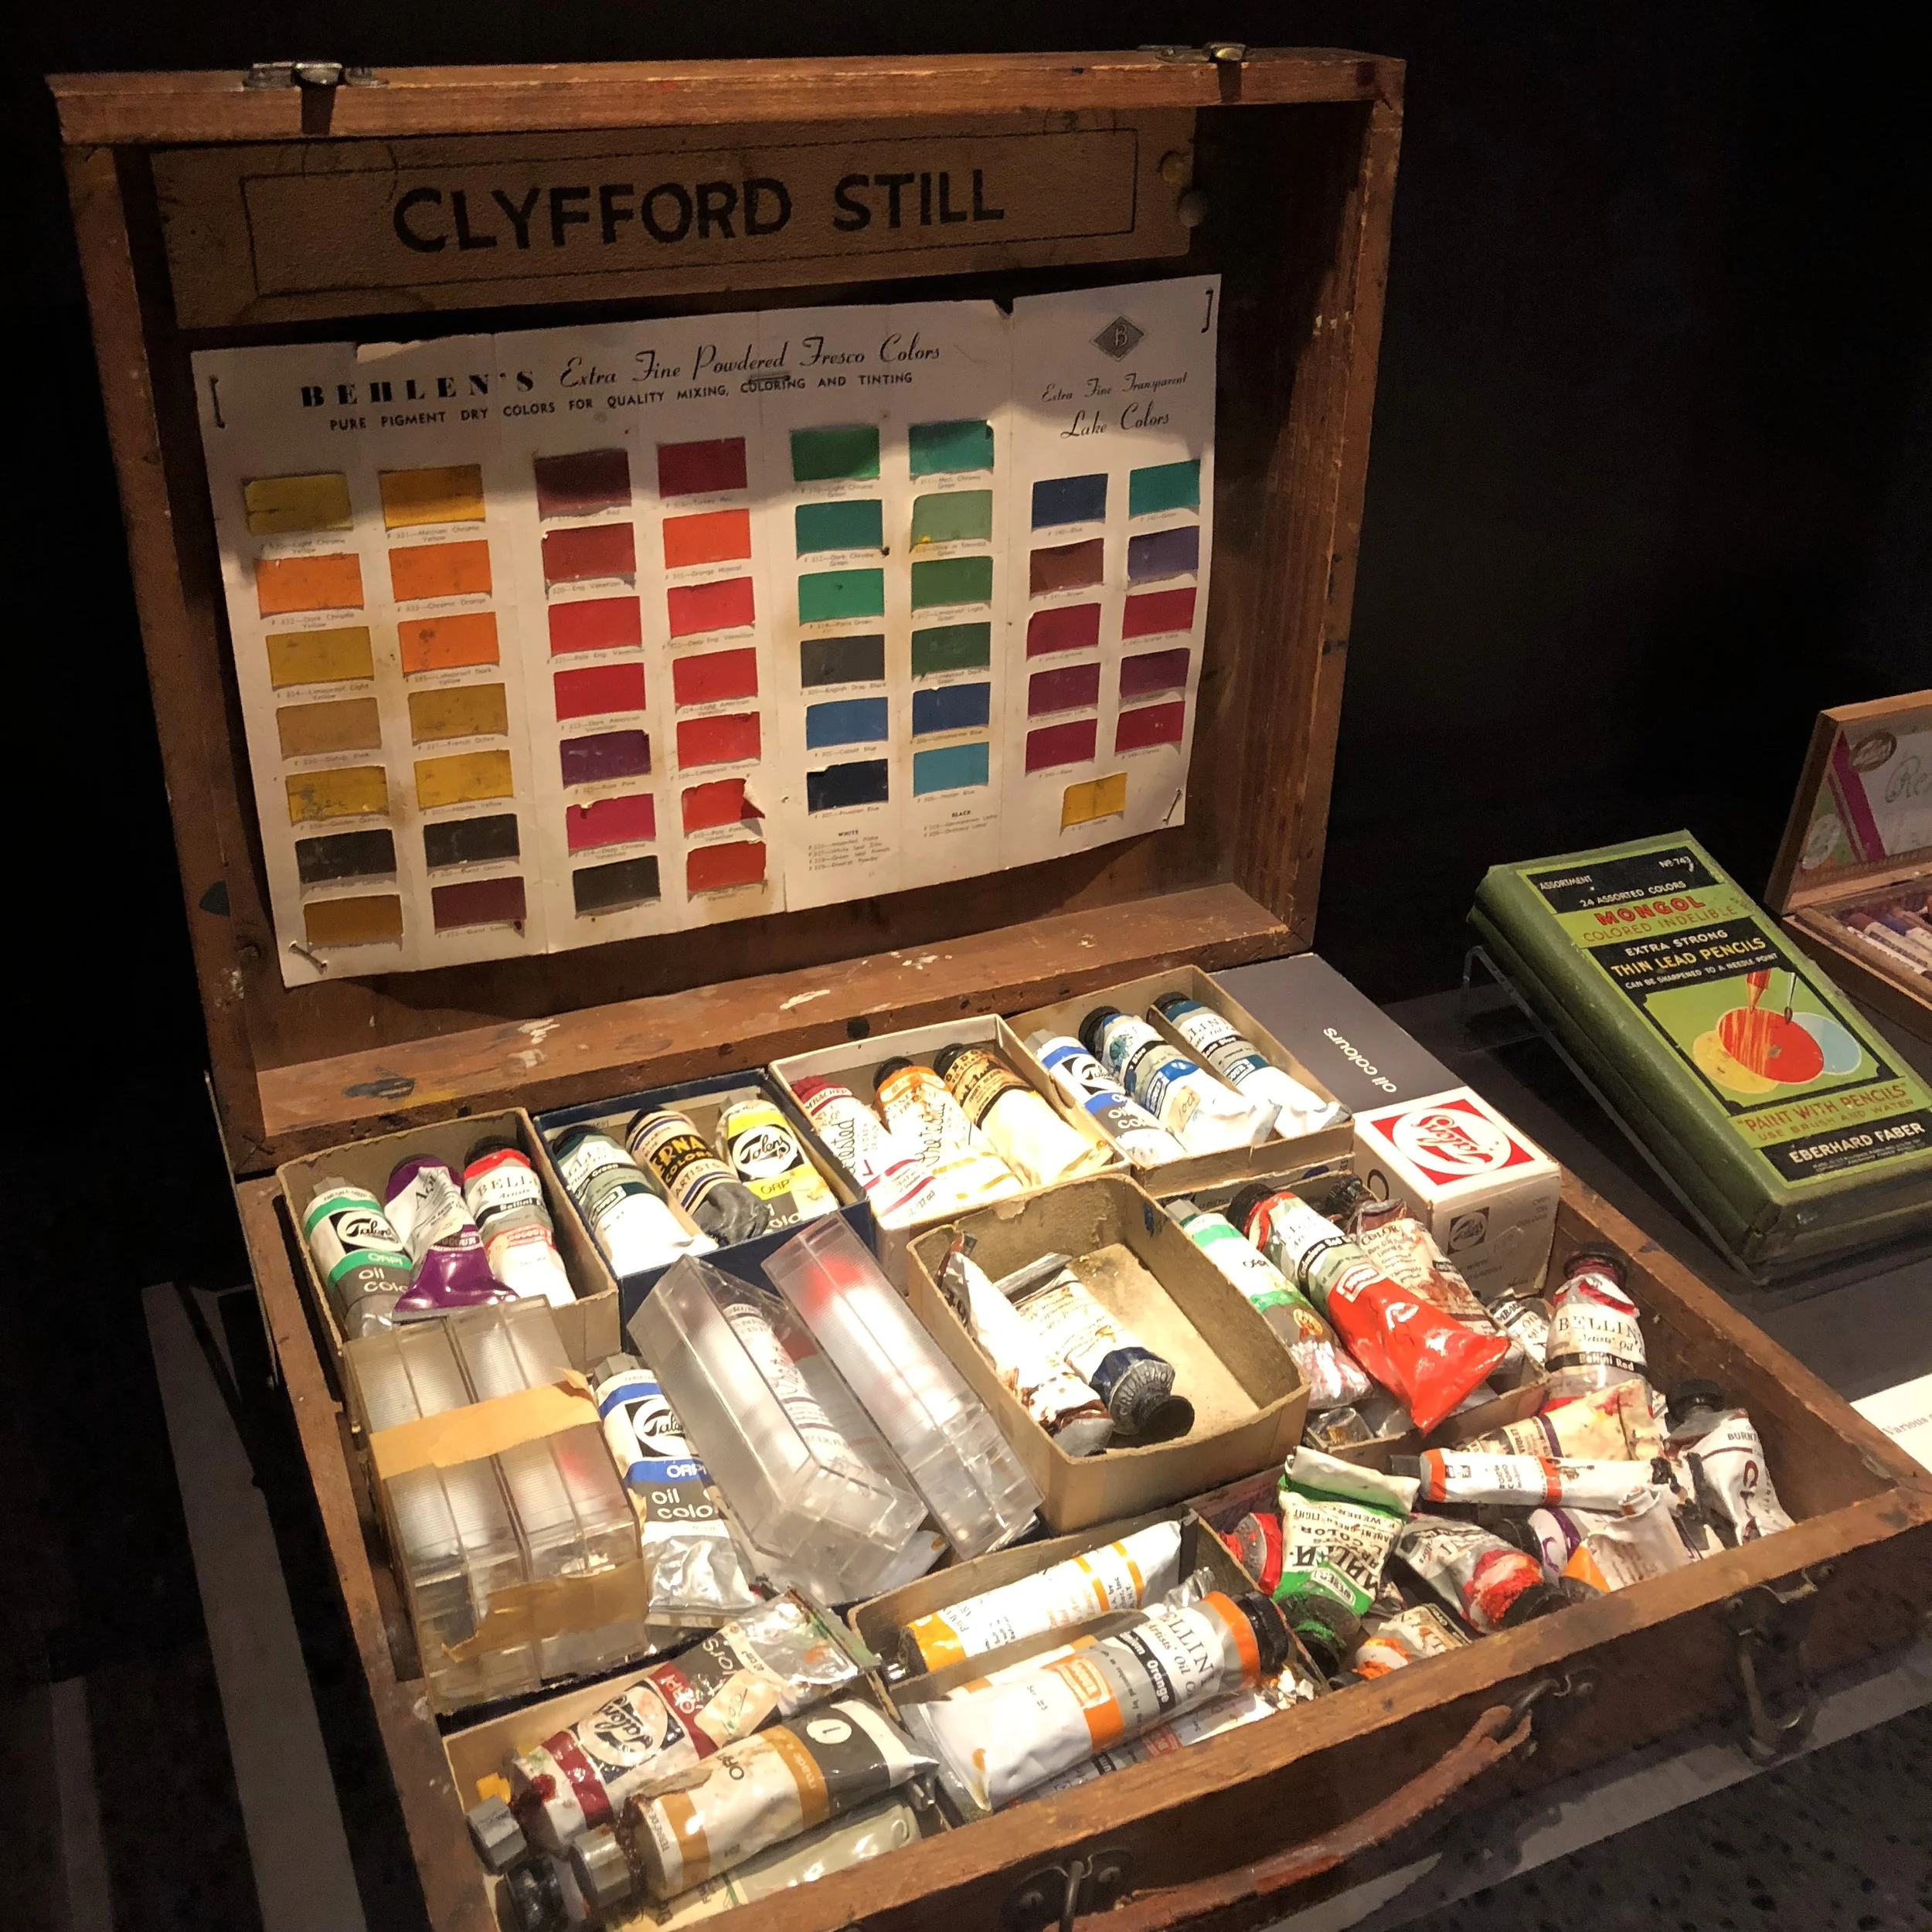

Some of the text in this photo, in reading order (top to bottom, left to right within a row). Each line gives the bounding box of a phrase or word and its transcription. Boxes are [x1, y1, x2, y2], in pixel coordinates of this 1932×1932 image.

[393, 168, 1005, 253] CLYFFORD STILL
[300, 332, 940, 407] BEHLEN'S Extra Fine Powdered Fresco Colors
[329, 371, 913, 432] PURE PIGMENT DRY COLORS FOR QUALITY MIXING, COLORING AND TINTING
[1042, 372, 1187, 402] Extra Fine Transparent
[1060, 402, 1170, 440] Lake Colors
[1539, 874, 1594, 889] ASSORTMENT
[1579, 880, 1686, 908] 24 ASSORTED COLORS
[1583, 905, 1738, 944] COLORED INDELIBLE
[1594, 895, 1706, 927] MONGOL
[1611, 937, 1767, 978] THIN LEAD PENCILS
[1625, 929, 1729, 957] EXTRA STRONG
[1625, 952, 1778, 990] CAN BE SHARPENED TO A NEEDLE POINT
[1323, 1026, 1397, 1093] oil colours
[1738, 1082, 1907, 1131] "PAINT WITH PENCILS"
[1758, 1099, 1914, 1140] USE BRUSH AND WATER
[739, 1134, 791, 1165] Talens
[1410, 1114, 1495, 1165] Talens
[1788, 1134, 1873, 1163] EBERHARD
[1874, 1122, 1926, 1142] FABER
[592, 1163, 619, 1177] Green
[675, 1162, 720, 1197] ARTISTS
[760, 1179, 791, 1196] ORP
[499, 1199, 533, 1212] Bellini
[359, 1267, 385, 1280] oil
[363, 1281, 410, 1294] colo
[1580, 1352, 1634, 1371] Bellini Red
[1619, 1341, 1634, 1352] Oil
[1883, 1416, 1929, 1436] Various
[651, 1488, 680, 1505] oil
[657, 1504, 713, 1519] colo
[1301, 1526, 1364, 1546] COLOR
[1173, 1655, 1191, 1675] Oil
[1148, 1660, 1170, 1703] Orange
[594, 1693, 653, 1750] Talens
